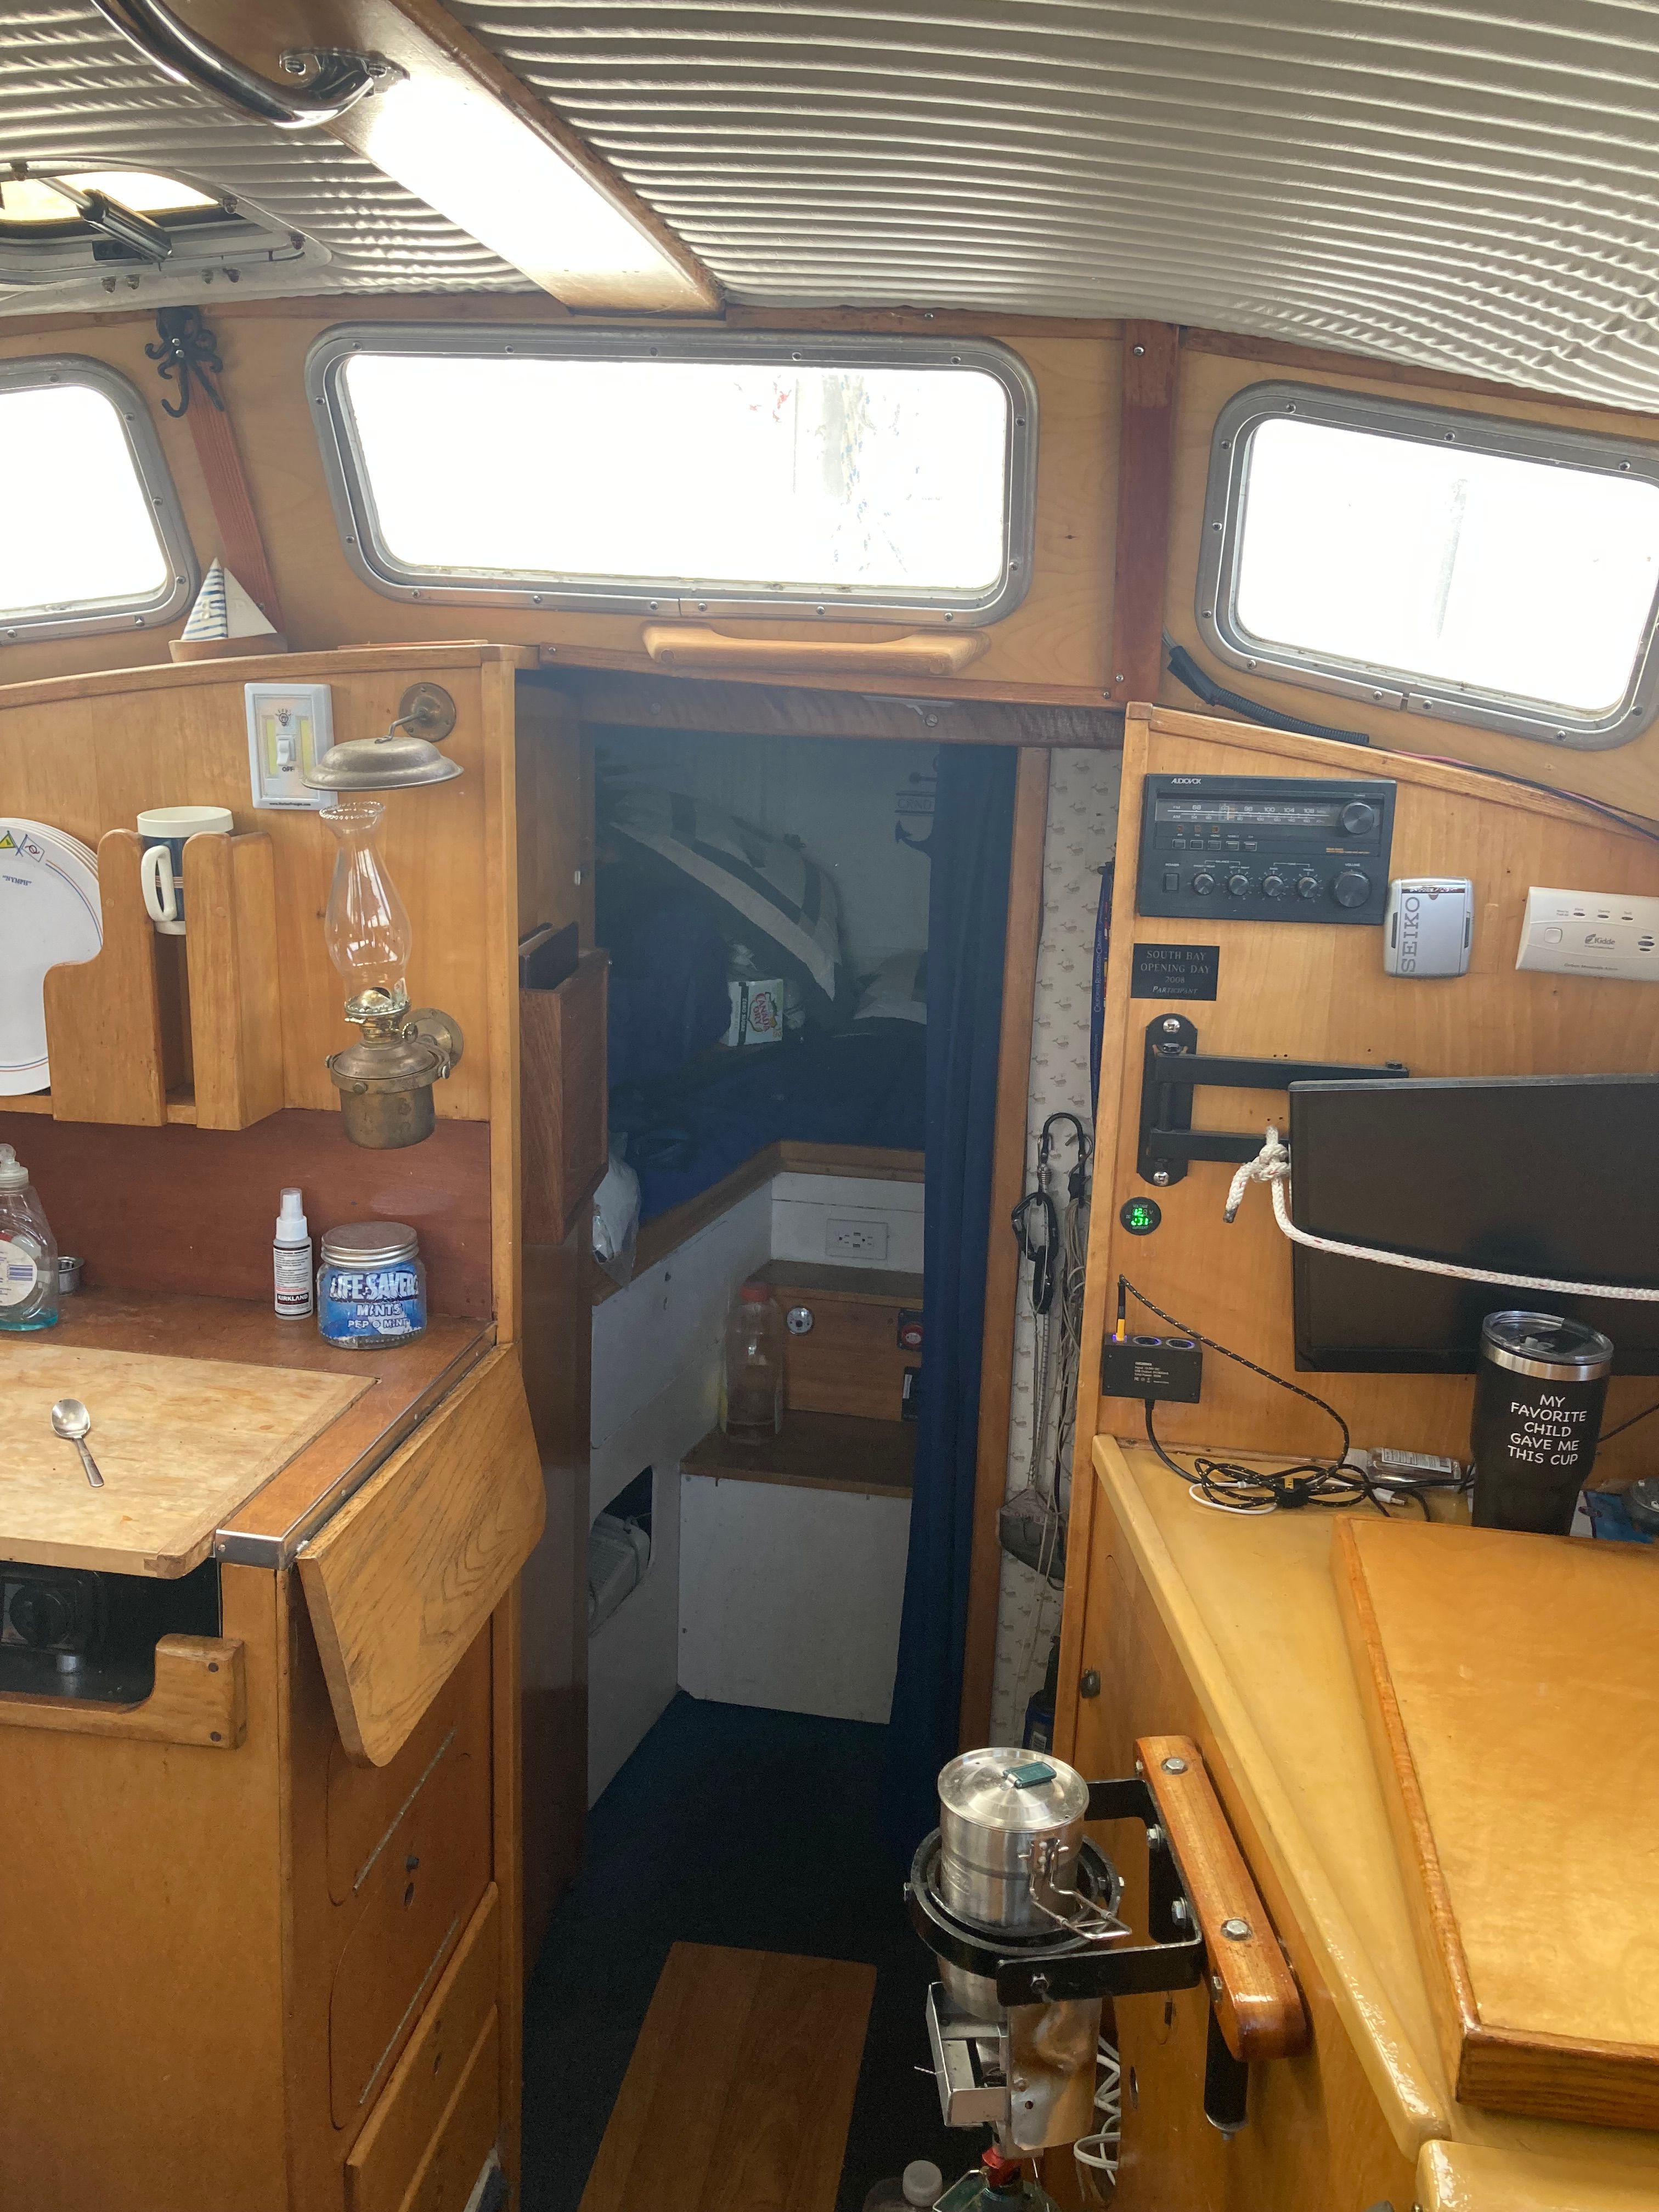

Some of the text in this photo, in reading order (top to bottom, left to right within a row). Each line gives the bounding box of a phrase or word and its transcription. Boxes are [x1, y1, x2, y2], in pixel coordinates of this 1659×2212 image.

[1401, 896, 1420, 973] SEIKO
[1594, 937, 1616, 945] Kidde
[1146, 950, 1207, 961] SOUTH BAY
[1141, 963, 1211, 974] OPENING DAY
[753, 1006, 761, 1025] DRY
[756, 993, 770, 1031] CANADA
[329, 1273, 364, 1301] LIFE
[356, 1304, 402, 1317] MINTS
[348, 1319, 369, 1328] PEP
[383, 1318, 408, 1328] MINT
[1539, 1394, 1566, 1408] MY
[1510, 1402, 1587, 1423] FAVORITE
[1523, 1421, 1572, 1437] CHILD
[1510, 1433, 1579, 1451] GAVE ME
[1506, 1444, 1579, 1466] THIS CUP
